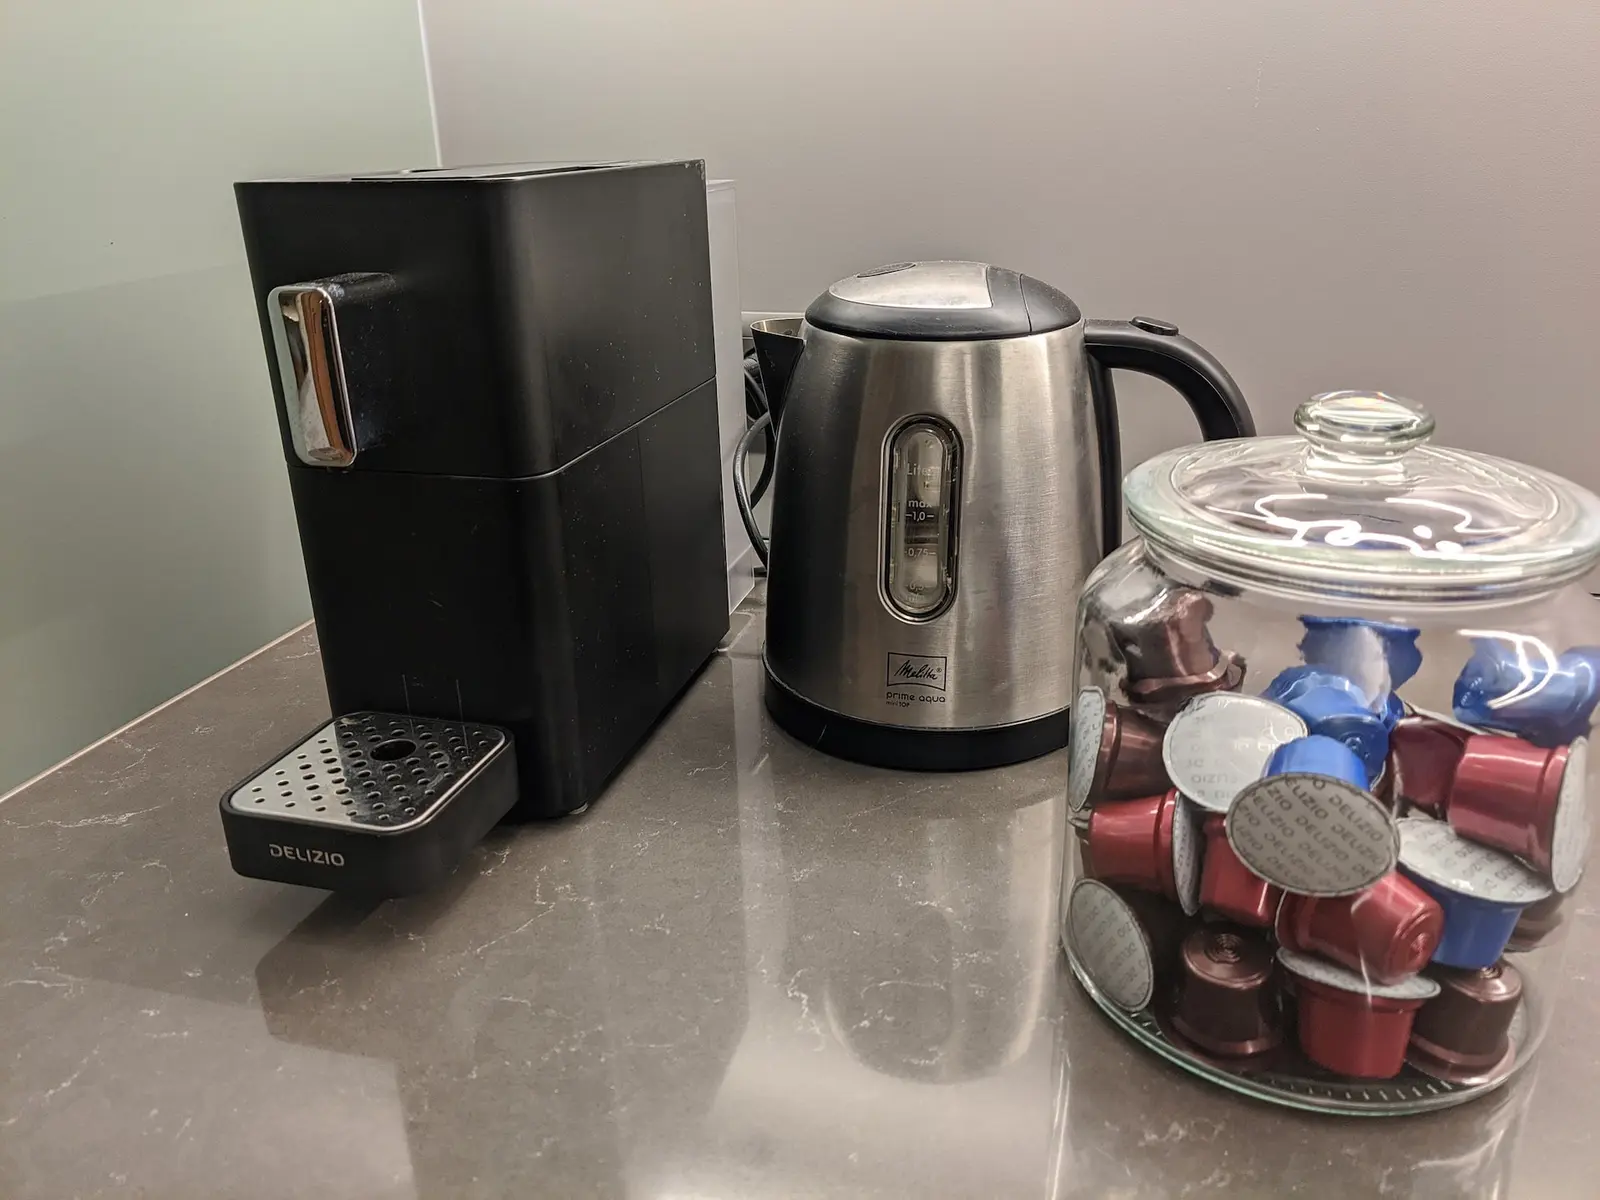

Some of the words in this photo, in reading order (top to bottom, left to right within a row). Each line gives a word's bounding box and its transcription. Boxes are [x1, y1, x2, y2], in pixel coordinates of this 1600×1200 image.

[908, 500, 932, 508] max
[893, 659, 938, 680] Melitta
[886, 691, 915, 701] prime
[919, 695, 946, 705] aqua
[1329, 794, 1384, 841] DELIZIO
[1296, 816, 1350, 861] DELIZIO
[268, 843, 345, 867] DELIZIO
